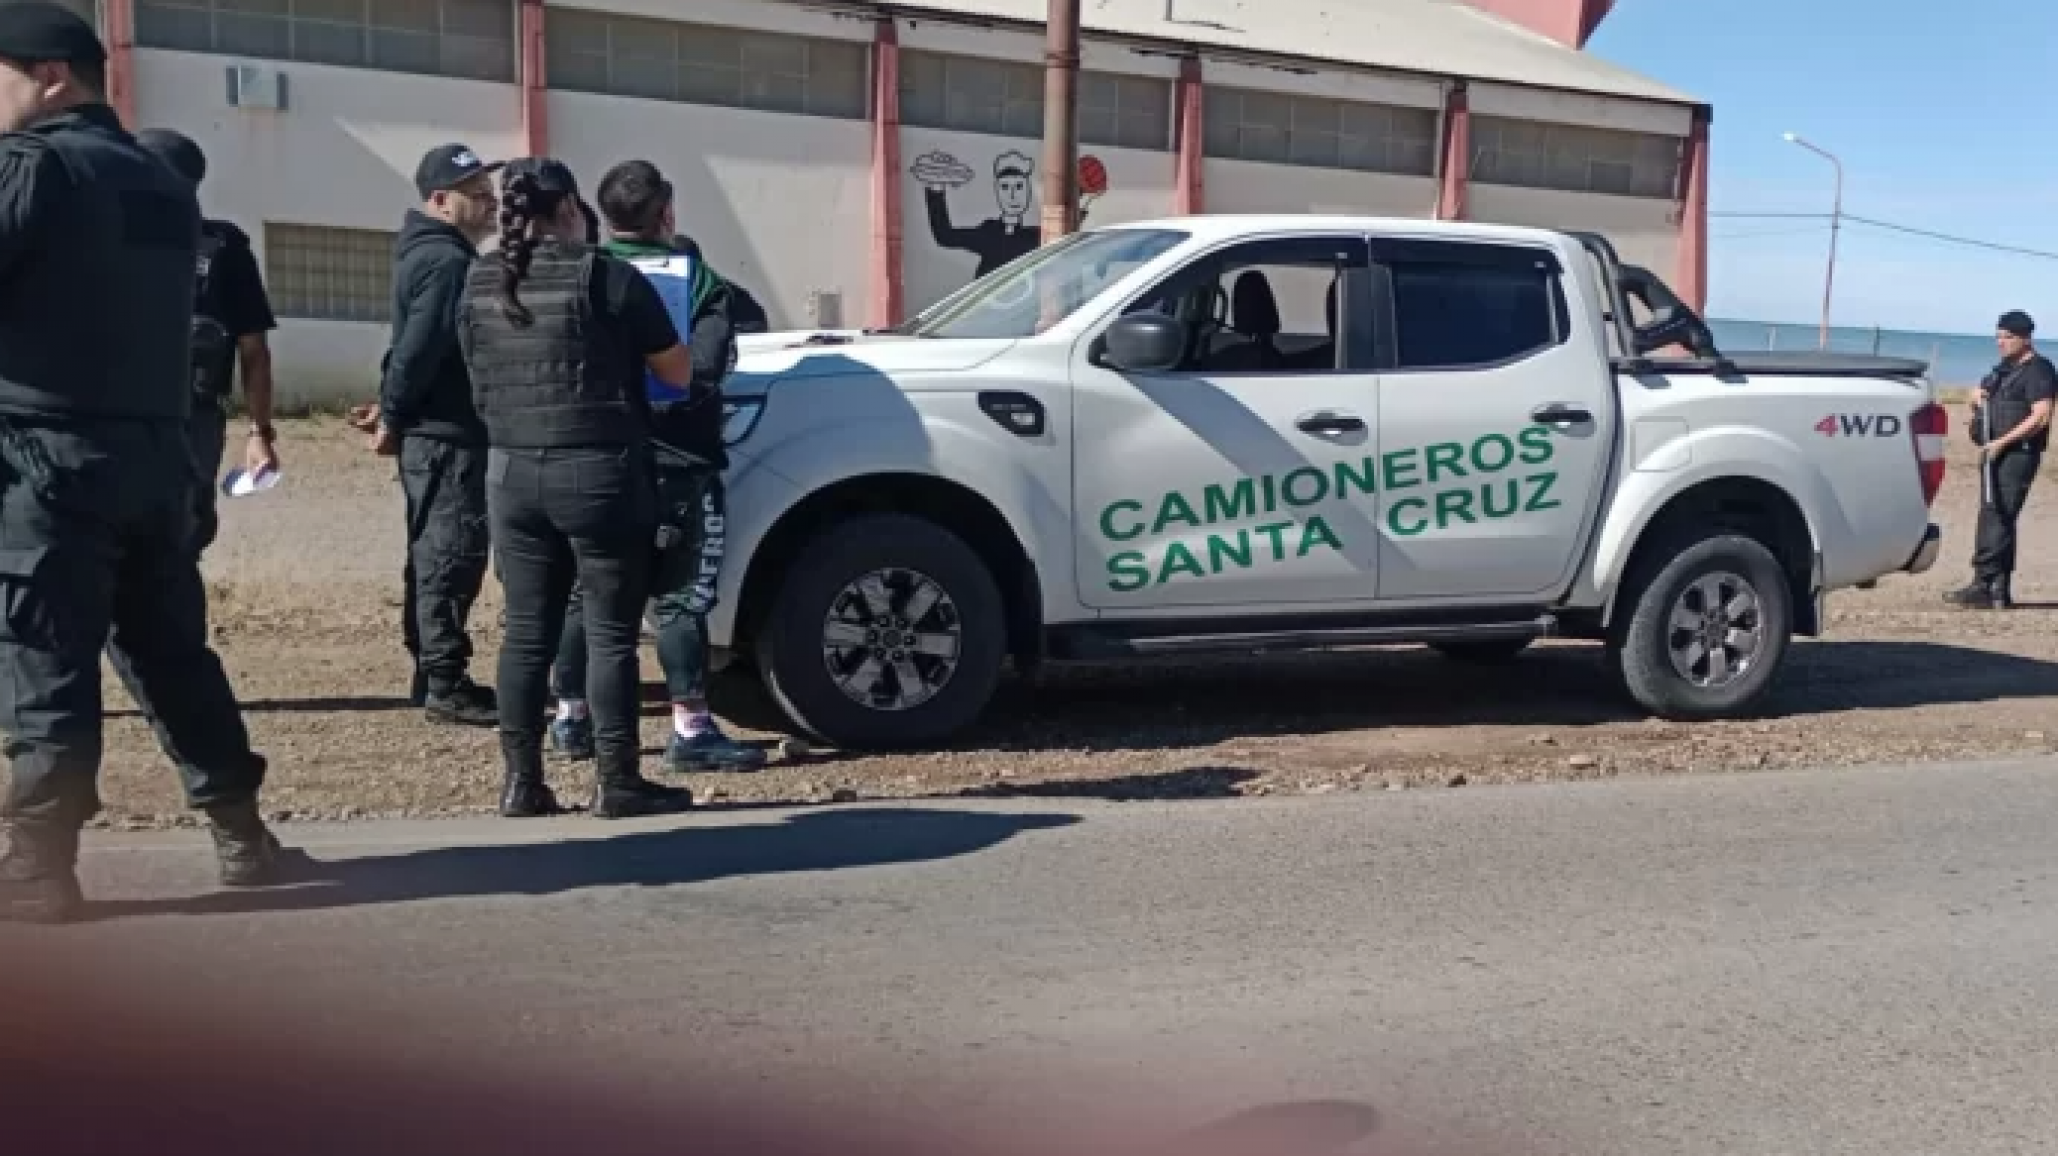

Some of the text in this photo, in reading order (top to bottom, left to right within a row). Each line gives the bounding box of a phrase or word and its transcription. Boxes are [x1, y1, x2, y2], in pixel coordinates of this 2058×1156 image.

[1814, 412, 1901, 437] 4WD
[1100, 427, 1554, 541] CAMIONEROS
[1106, 471, 1562, 592] SANTA CRUZ
